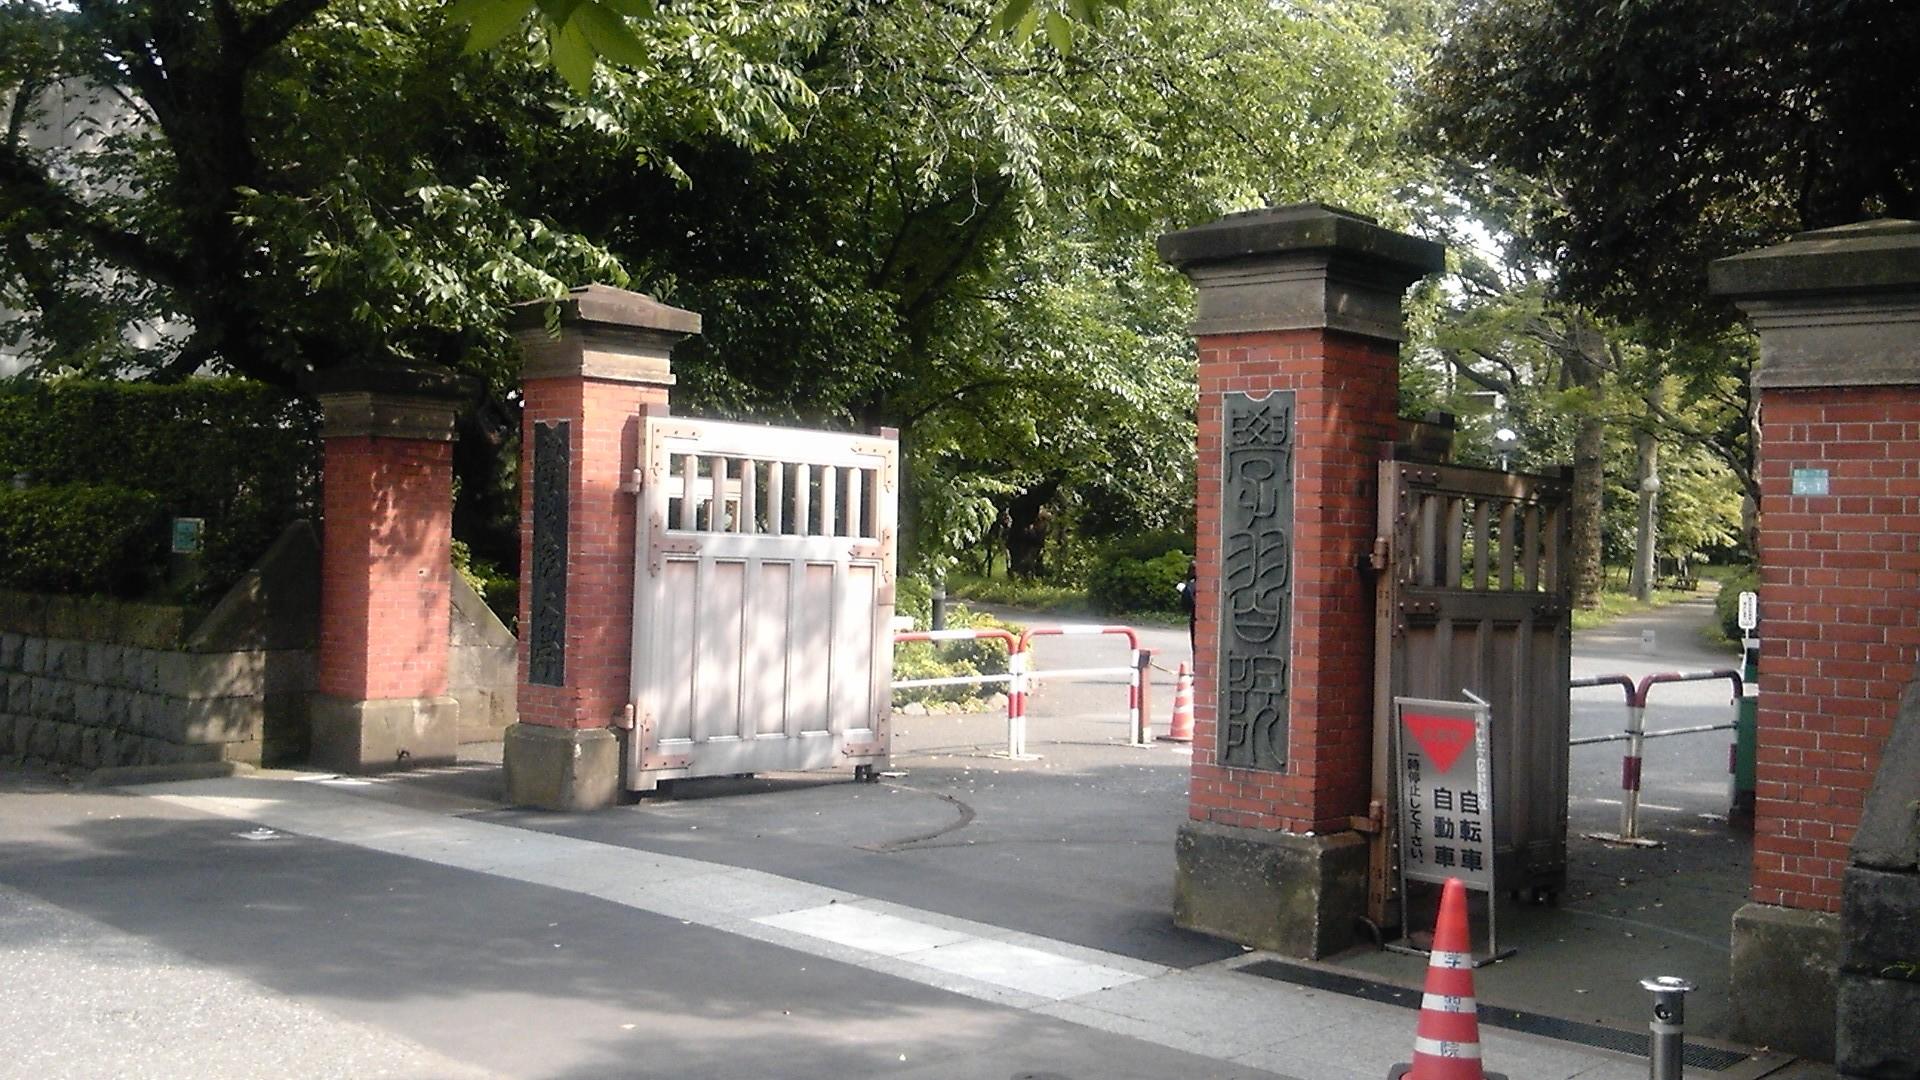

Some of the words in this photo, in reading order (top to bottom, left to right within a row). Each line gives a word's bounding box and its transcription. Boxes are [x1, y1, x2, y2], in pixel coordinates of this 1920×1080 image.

[1433, 787, 1457, 867] 自動車
[1459, 790, 1484, 872] 自転車
